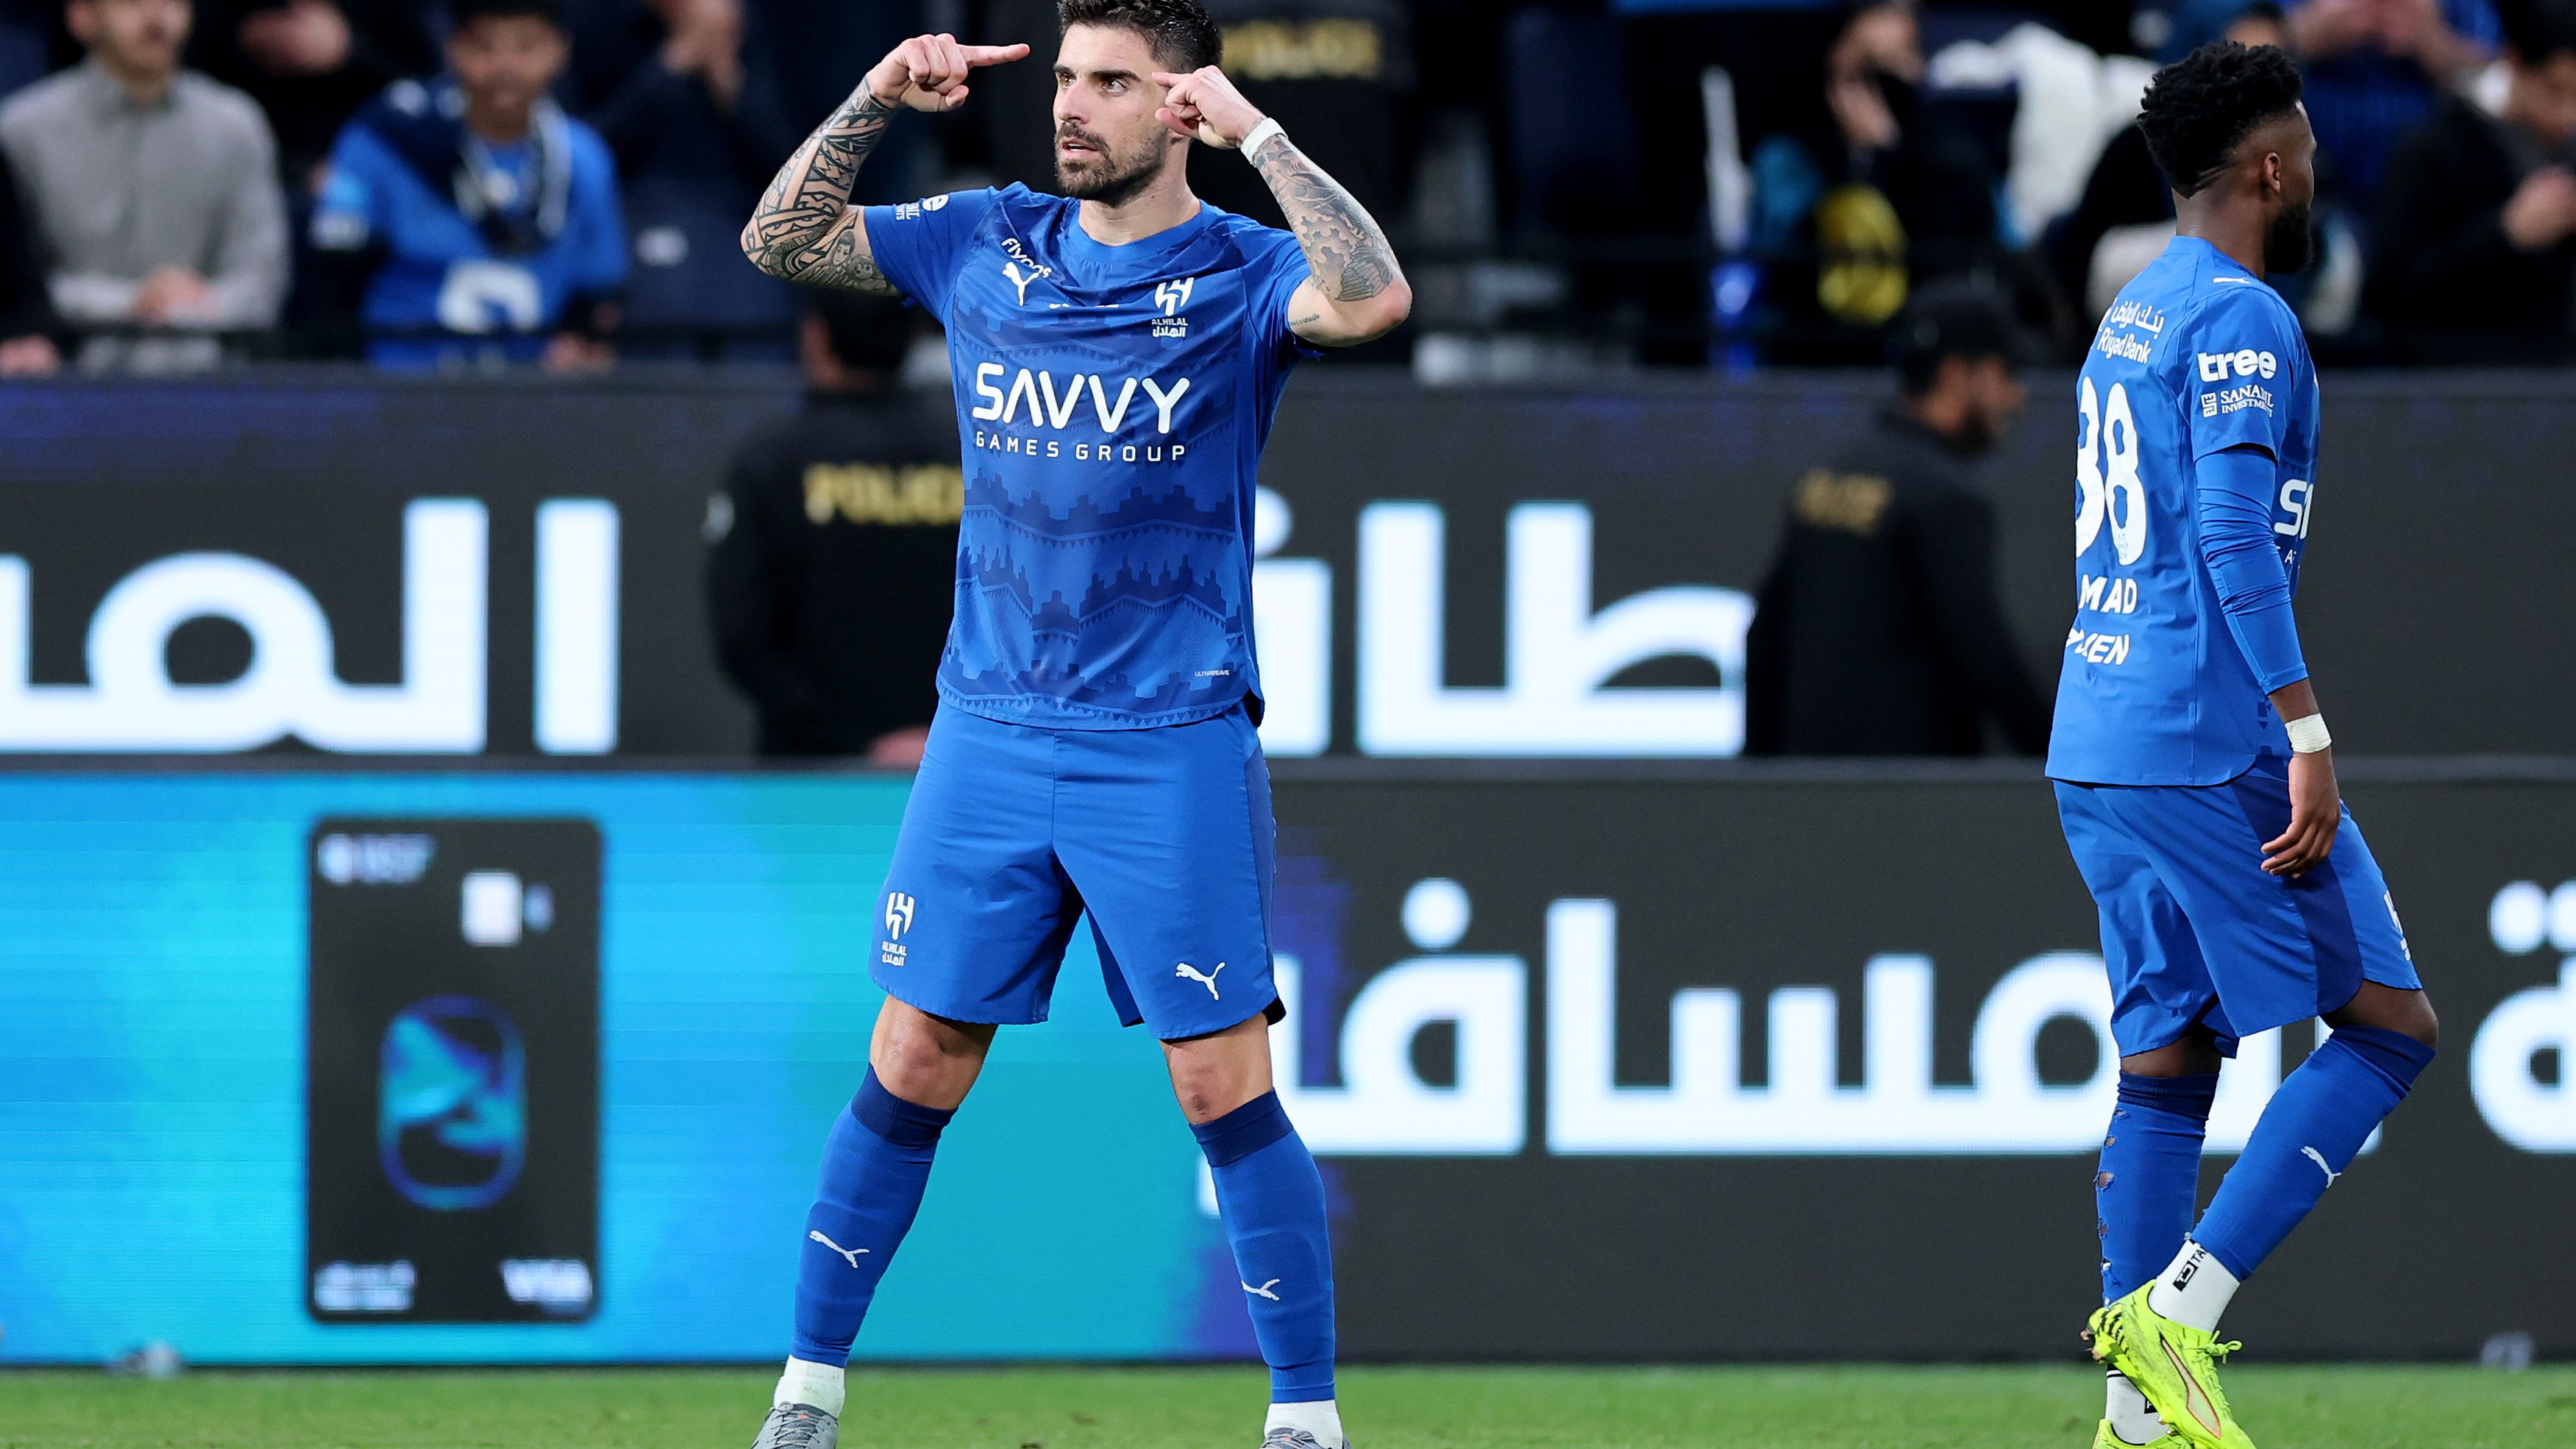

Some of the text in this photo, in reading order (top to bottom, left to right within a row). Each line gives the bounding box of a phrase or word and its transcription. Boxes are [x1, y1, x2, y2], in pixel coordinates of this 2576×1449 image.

[2096, 327, 2152, 364] Riyad Bank
[2197, 349, 2277, 382] tree
[972, 362, 1190, 434] SAVVY
[975, 431, 1186, 463] GAMES GROUP
